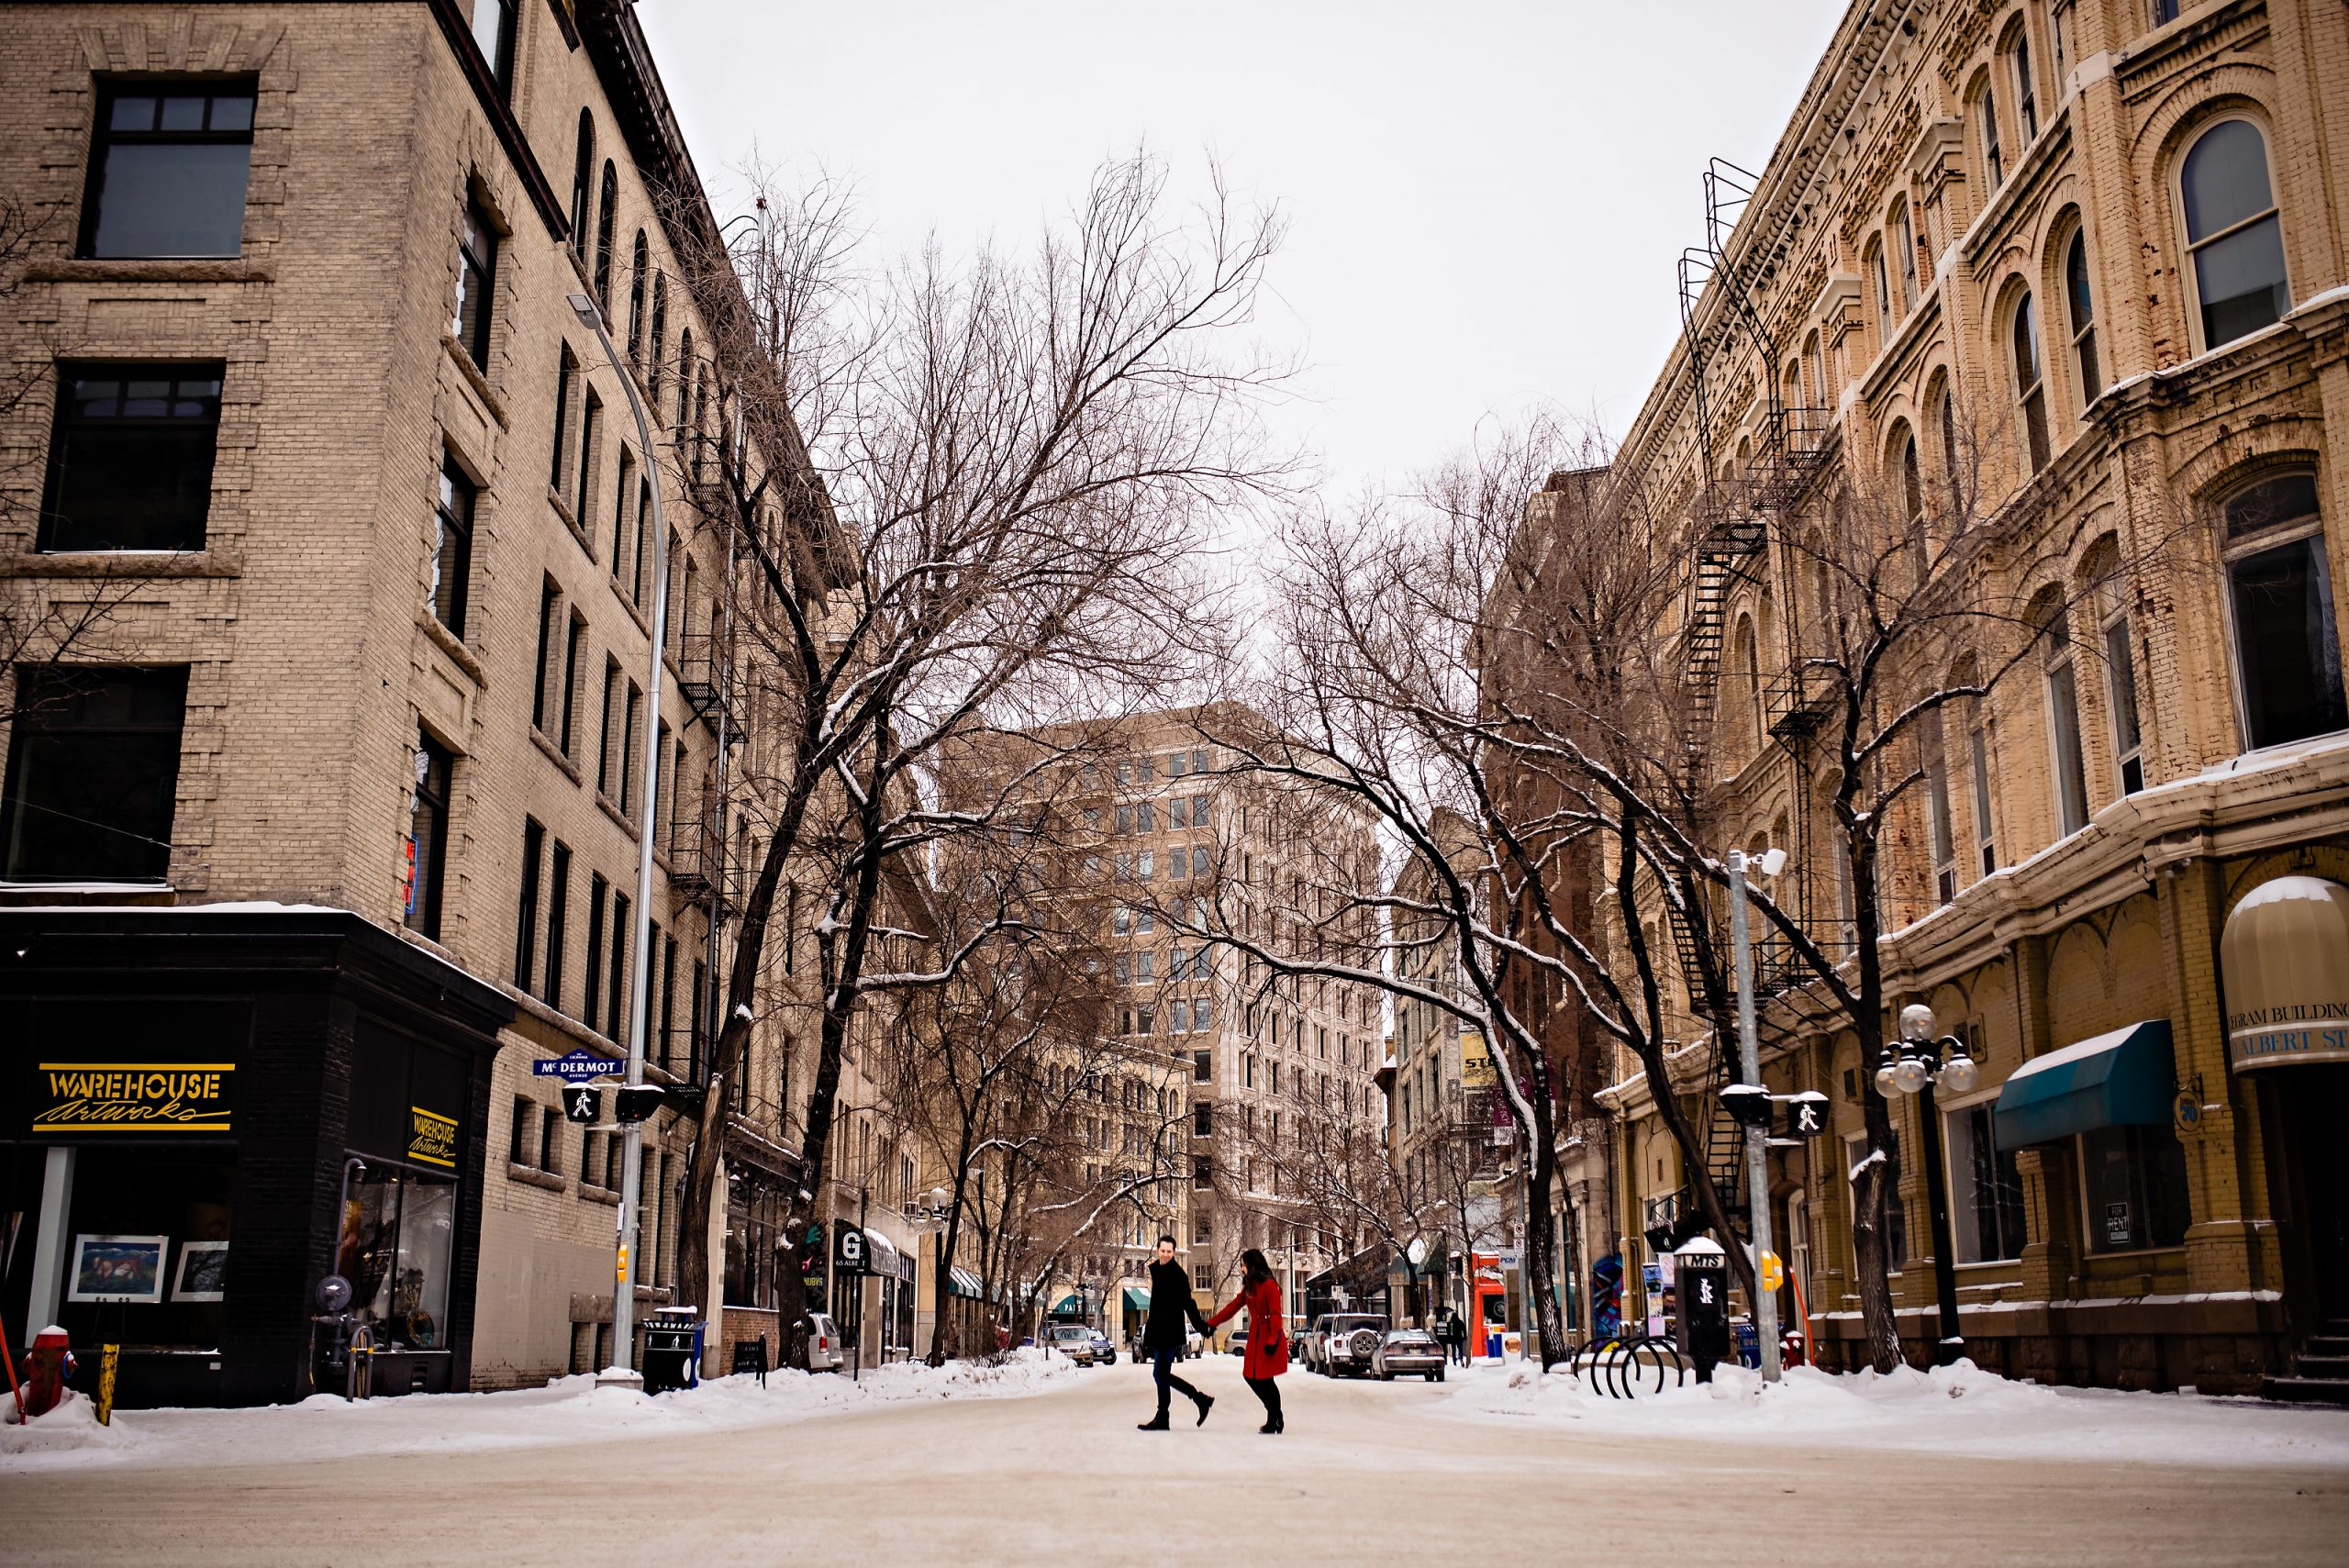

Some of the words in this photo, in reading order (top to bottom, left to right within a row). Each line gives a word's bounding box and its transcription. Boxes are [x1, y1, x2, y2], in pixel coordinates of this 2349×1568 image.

[2229, 1008, 2267, 1029] EGRAM
[2242, 1030, 2311, 1056] ALBERT
[561, 1062, 616, 1073] DERMOT
[50, 1073, 220, 1099] WAREHOUSE
[34, 1098, 231, 1121] Artworks
[414, 1114, 455, 1144] WAREHOUSE
[2111, 1206, 2122, 1217] FOR
[2108, 1216, 2128, 1231] RENT
[842, 1231, 861, 1260] G
[1691, 1255, 1720, 1267] MTS
